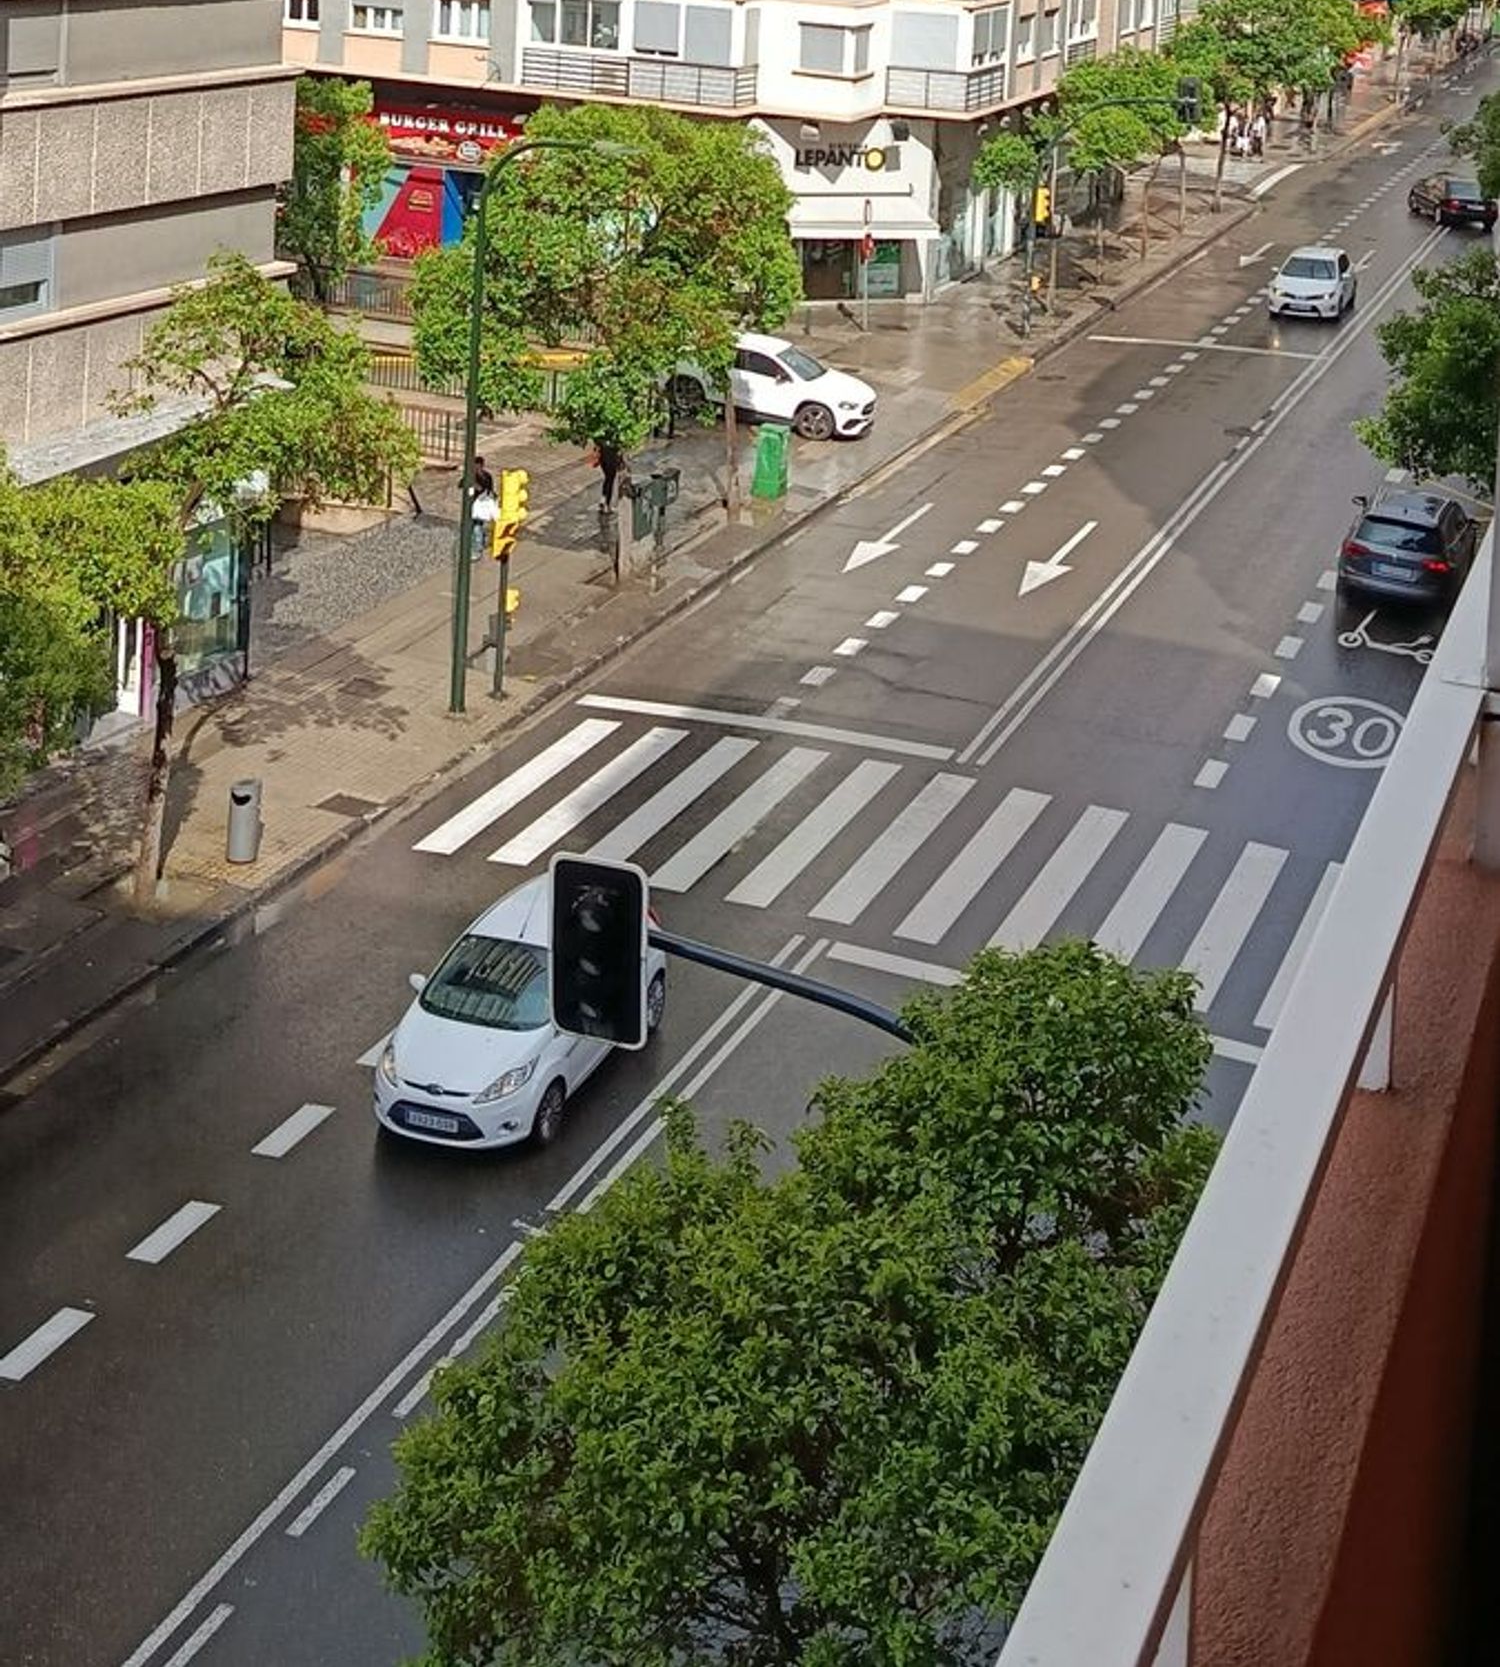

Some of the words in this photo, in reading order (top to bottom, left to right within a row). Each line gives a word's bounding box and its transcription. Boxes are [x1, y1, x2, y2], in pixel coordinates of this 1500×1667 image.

[379, 112, 450, 133] BURGER
[454, 121, 507, 138] GRILL
[796, 148, 885, 171] LEPANTO
[1306, 706, 1396, 757] 30
